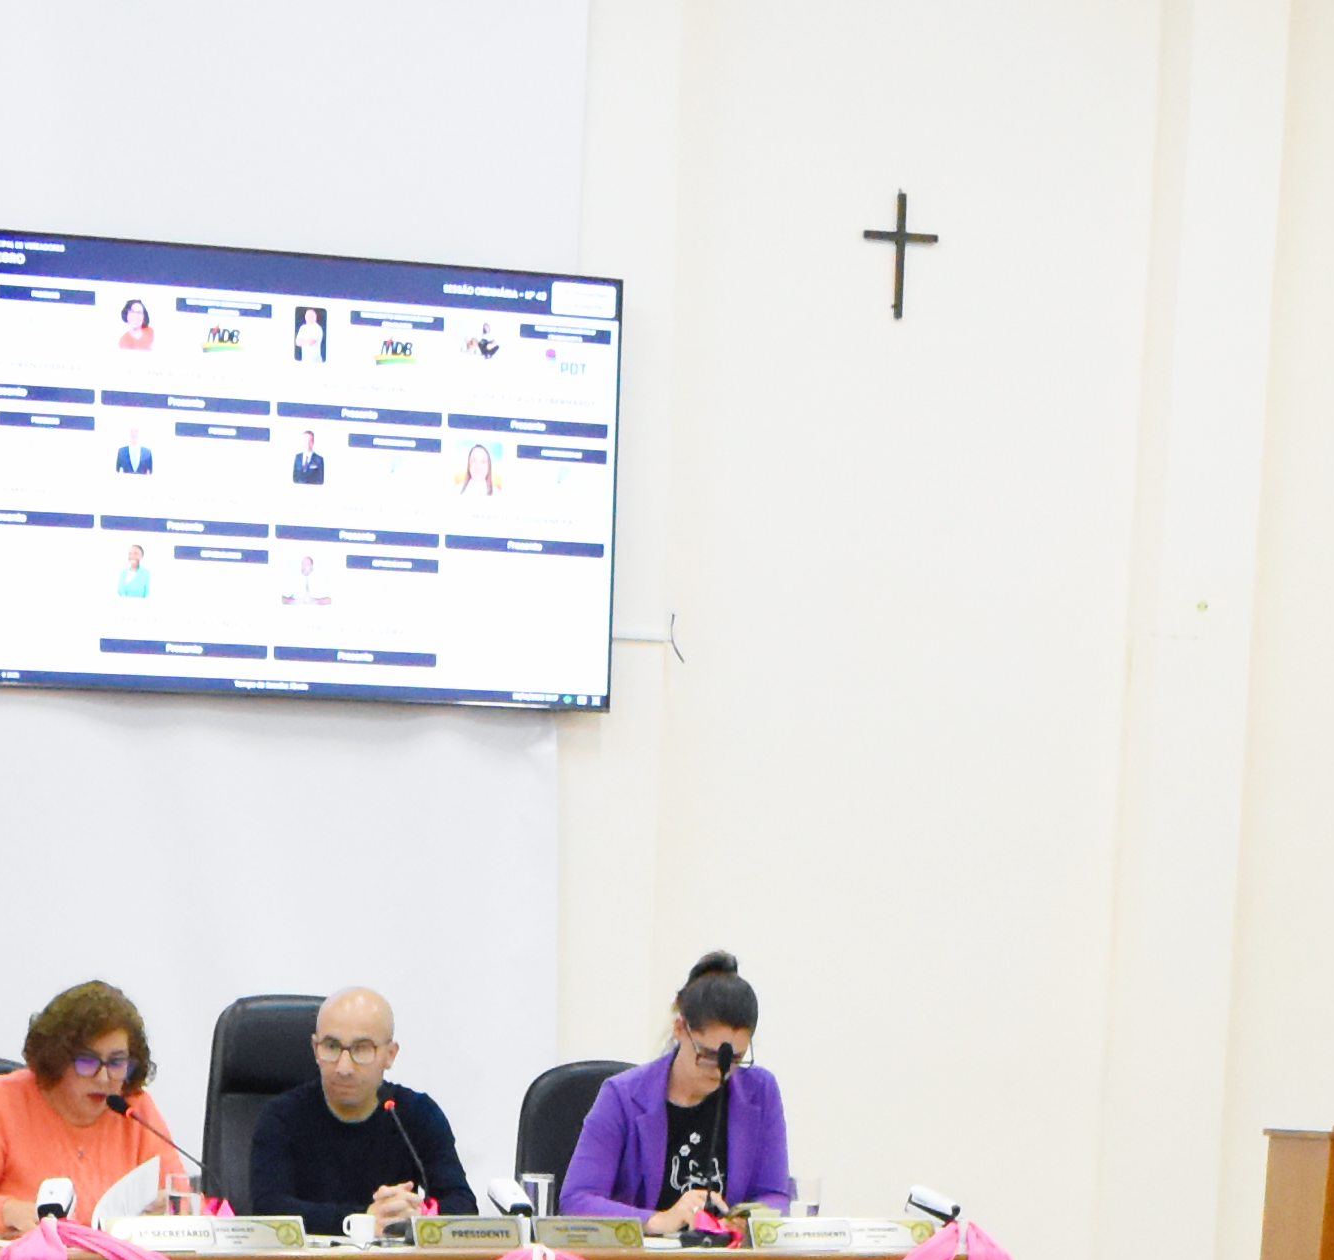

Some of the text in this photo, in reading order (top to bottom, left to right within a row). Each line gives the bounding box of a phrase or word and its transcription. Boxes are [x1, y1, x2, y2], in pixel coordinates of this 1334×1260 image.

[207, 326, 241, 345] MDB
[379, 338, 413, 357] MDB
[560, 361, 587, 376] PDT
[451, 1229, 511, 1239] PRESIDENTE
